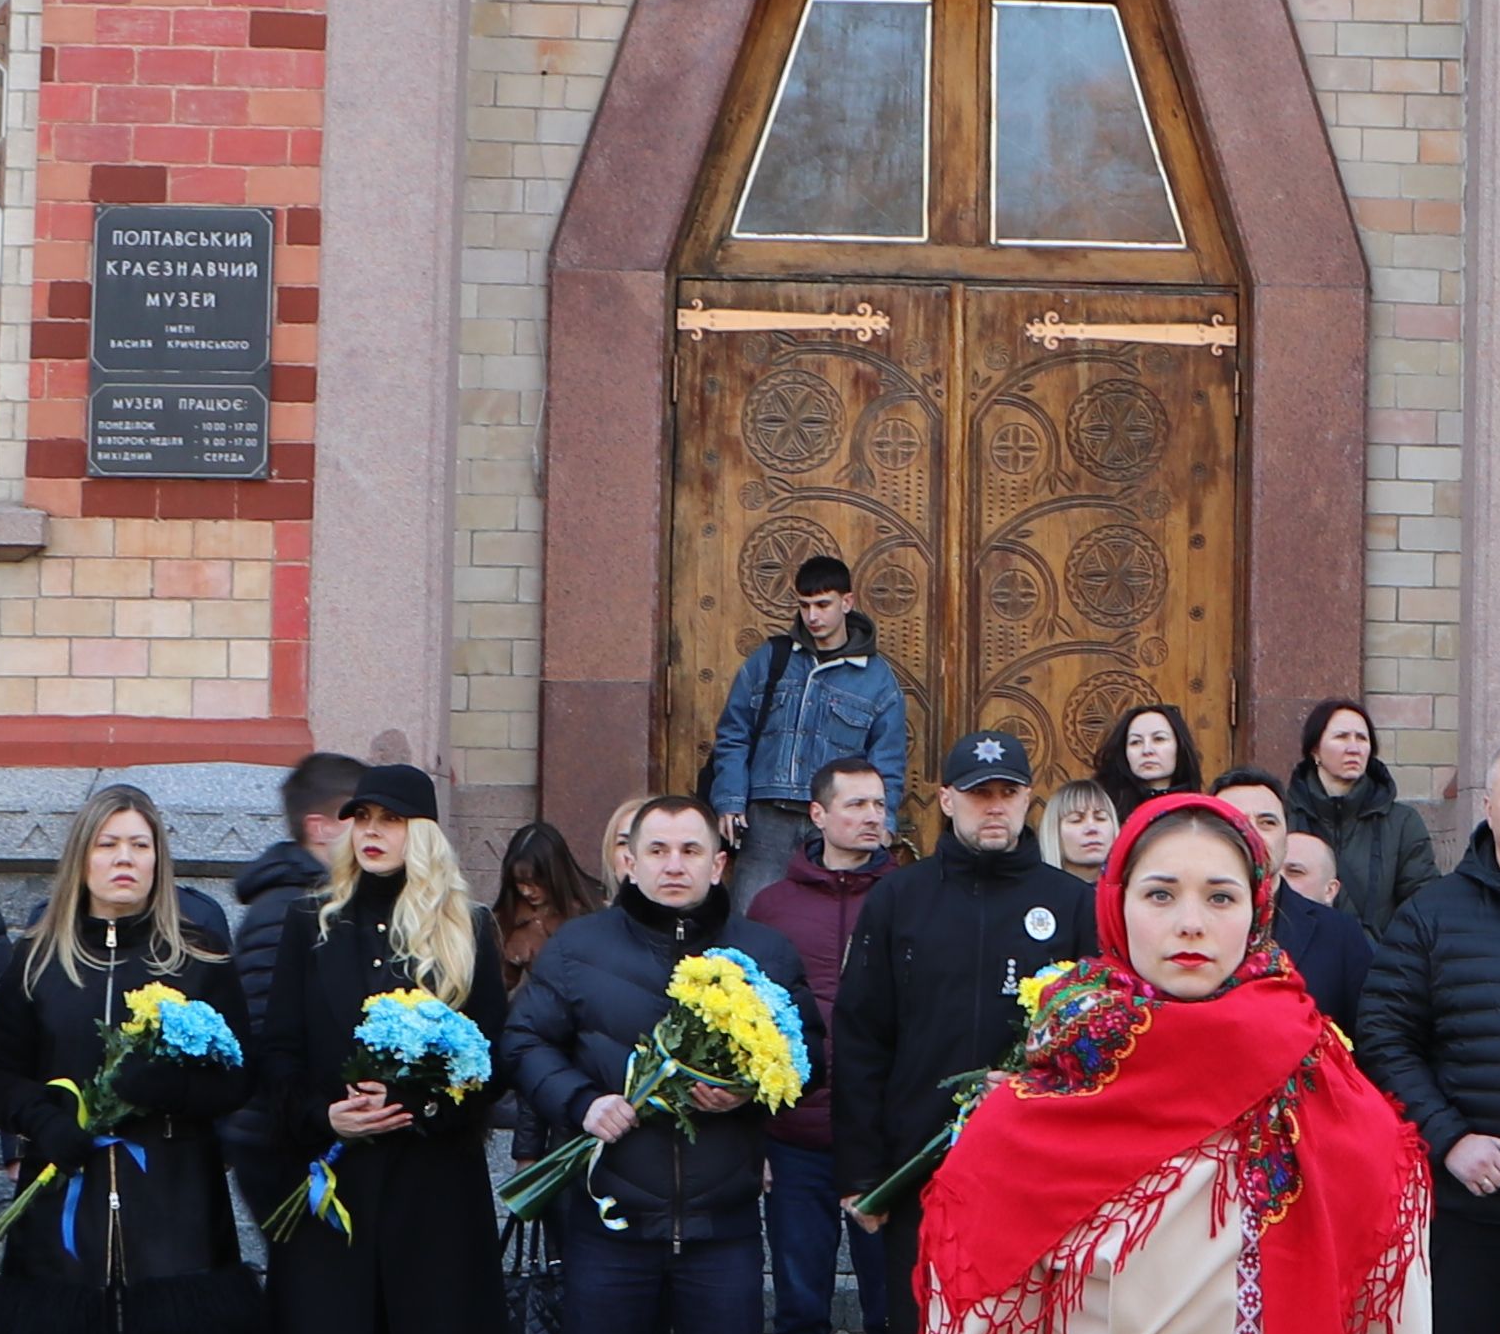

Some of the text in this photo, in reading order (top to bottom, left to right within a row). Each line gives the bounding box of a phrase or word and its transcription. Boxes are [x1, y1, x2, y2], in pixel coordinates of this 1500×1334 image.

[112, 230, 253, 247] ПОЛТАВСЬКИЙ
[106, 260, 258, 278] КРАЄЗНАВЧИЙ
[146, 292, 216, 307] МУЗЕЙ
[110, 339, 250, 350] ВАСИЛЯ КРИЧЕВСЬКОГО
[112, 398, 248, 411] МУЗЕЙ ПРАЦЮЄ:
[203, 452, 245, 462] СЕРЕДА
